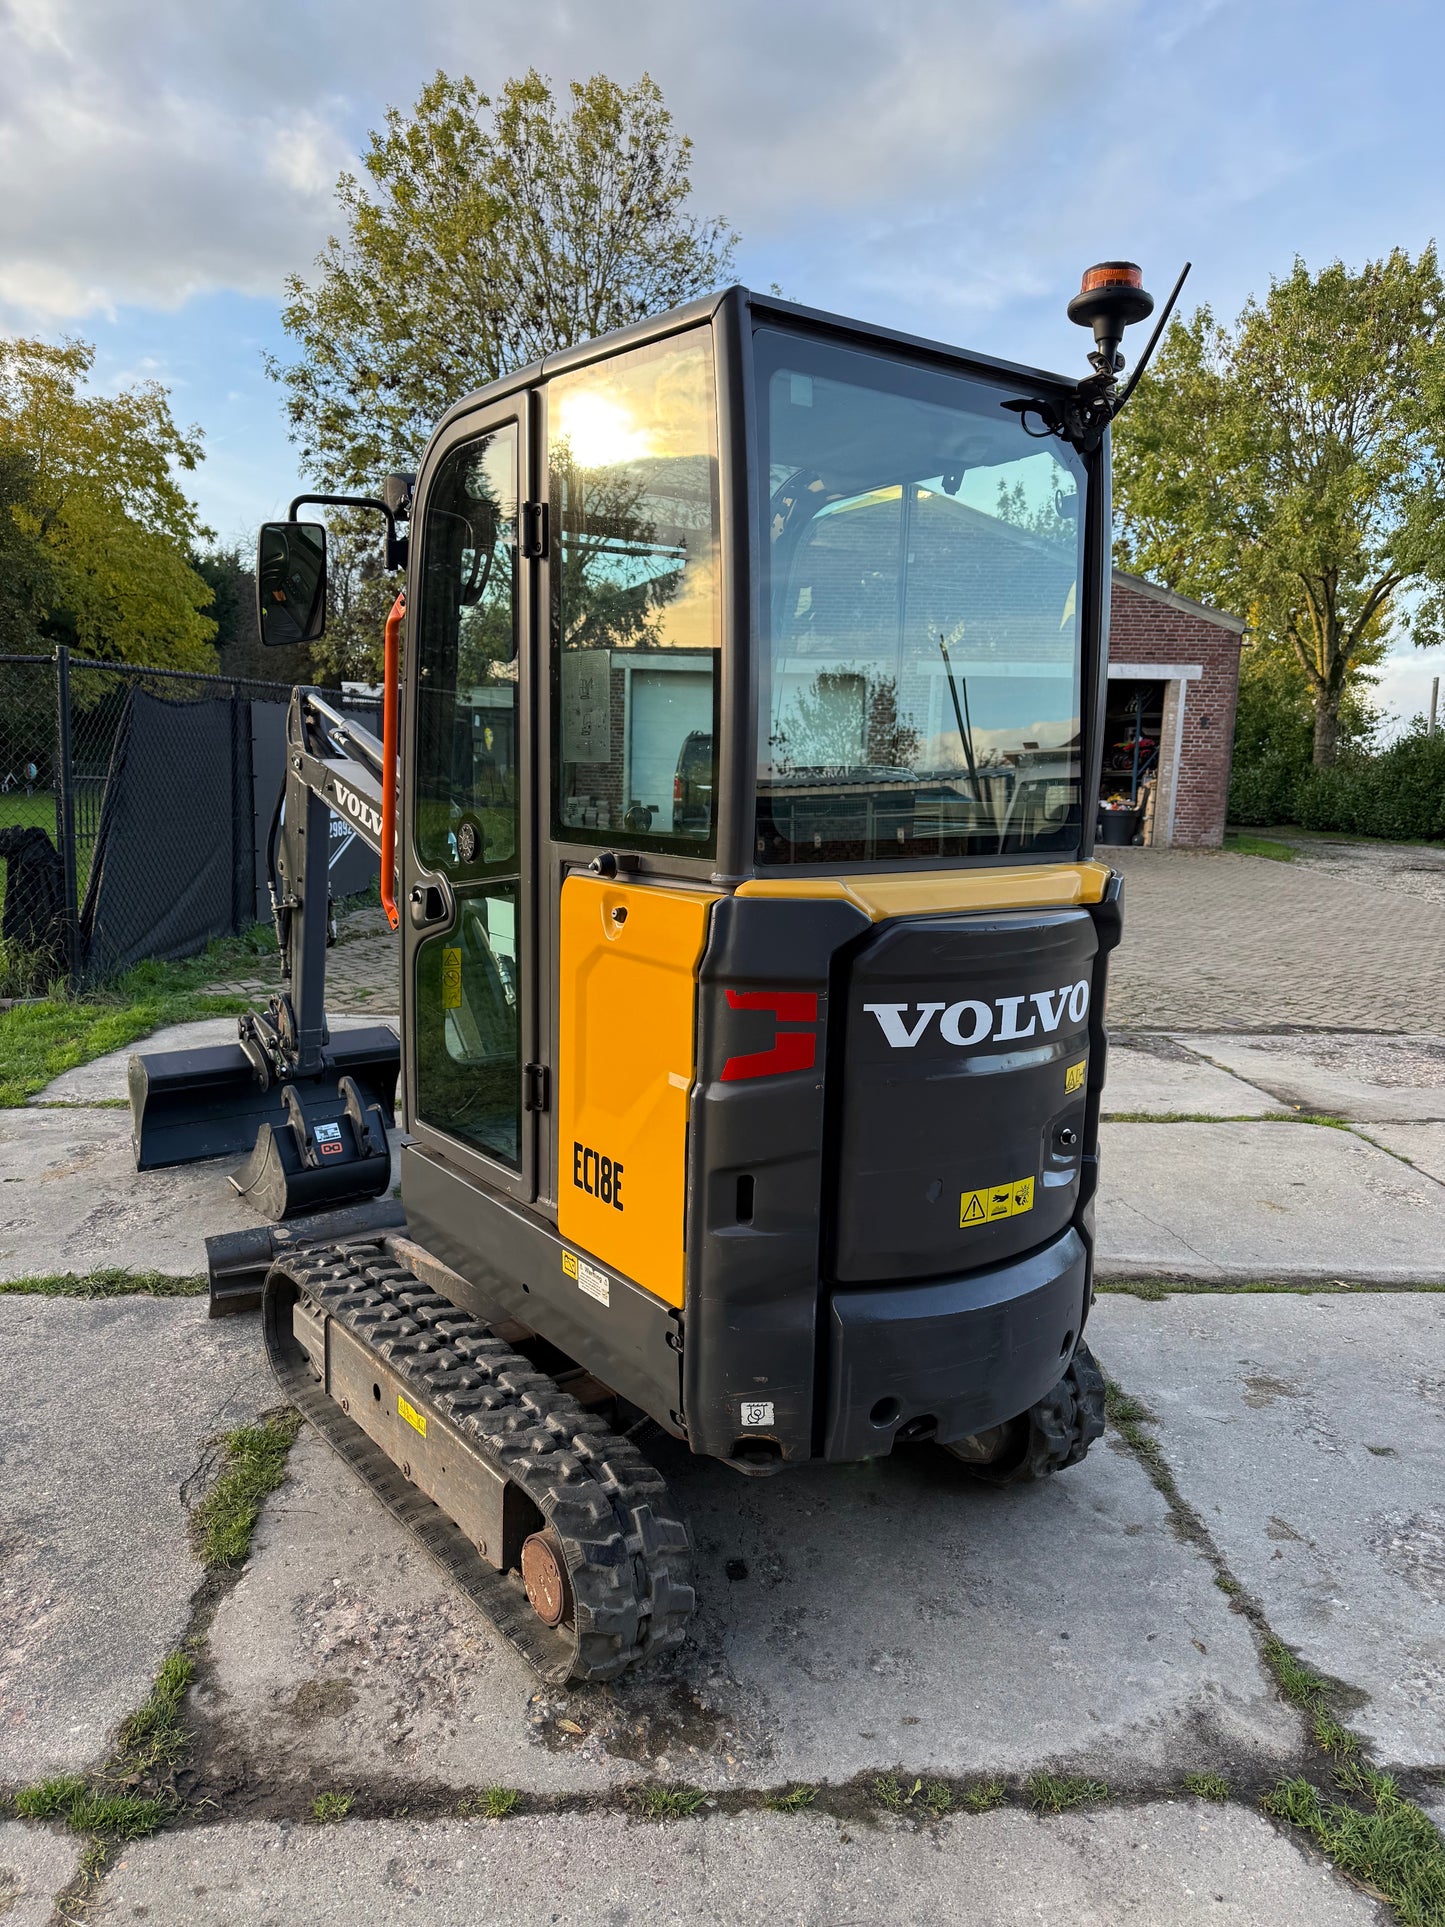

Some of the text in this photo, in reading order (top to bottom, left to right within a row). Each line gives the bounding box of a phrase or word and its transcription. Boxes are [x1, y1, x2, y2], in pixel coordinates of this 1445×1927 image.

[333, 778, 398, 848] VOLV
[863, 979, 1089, 1048] VOLVO
[573, 1140, 624, 1212] EC18E
